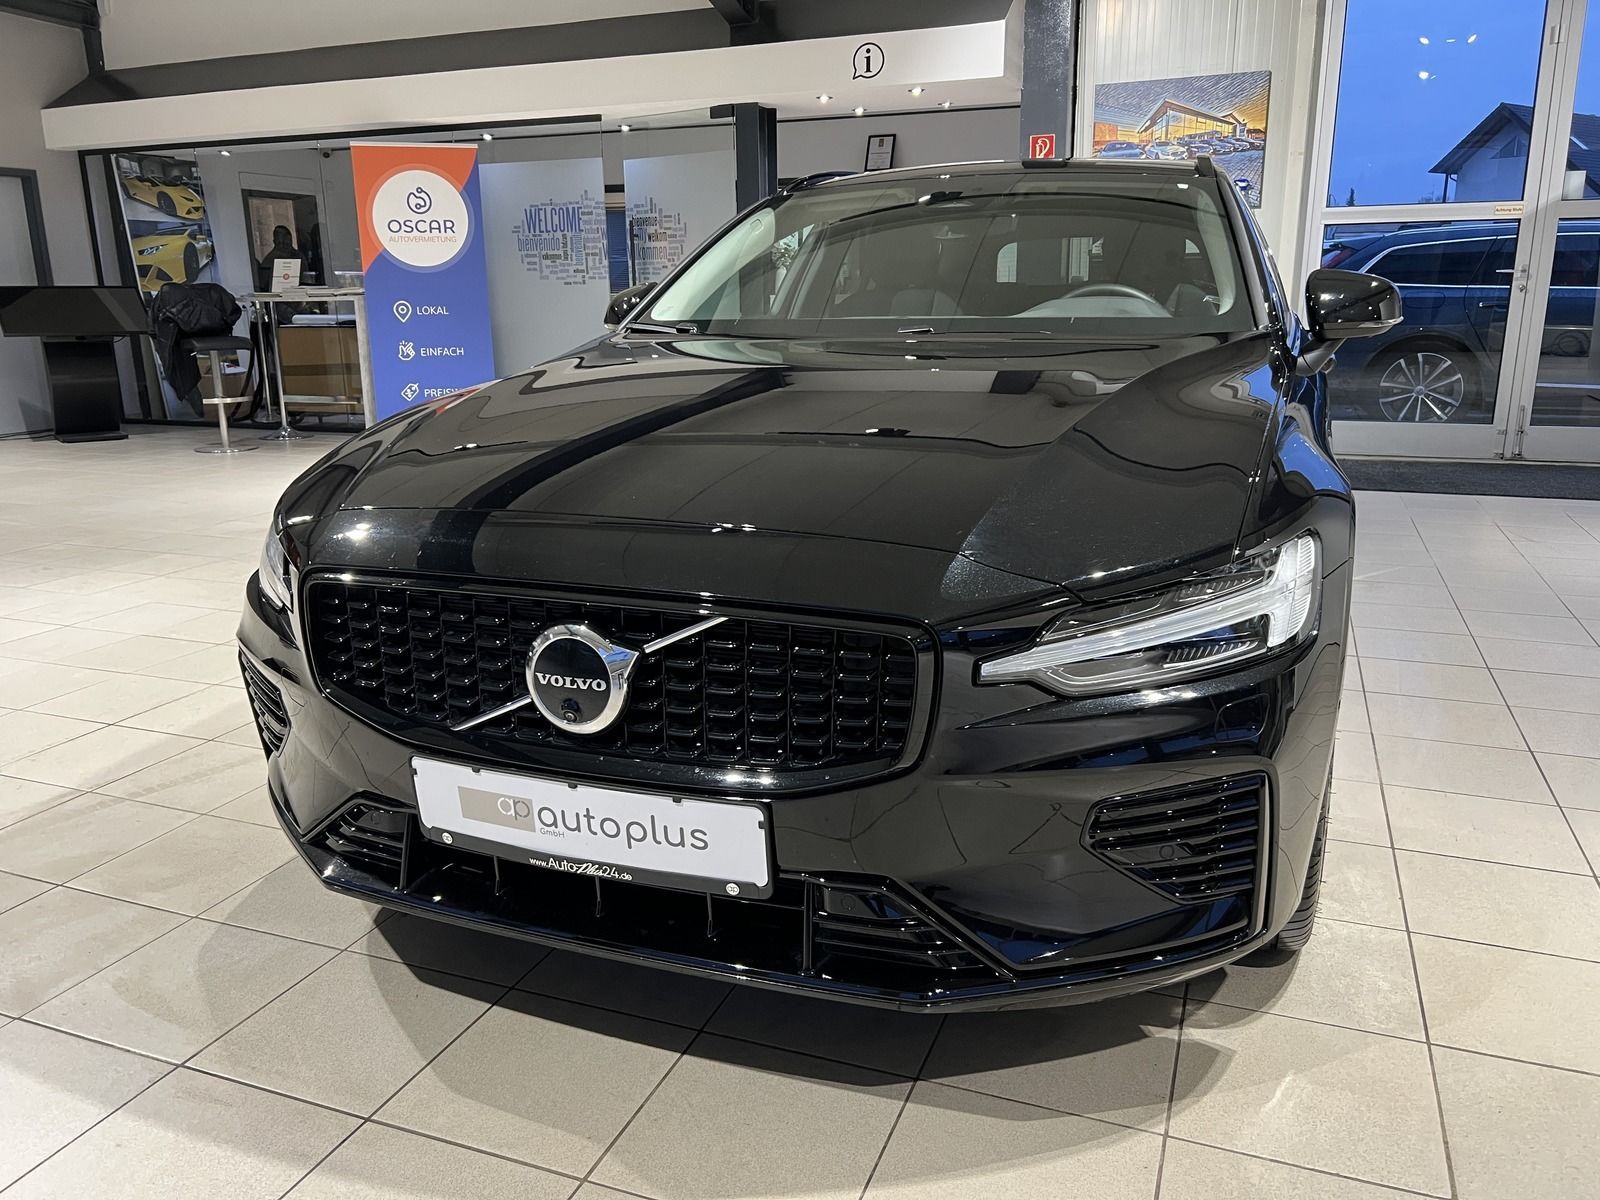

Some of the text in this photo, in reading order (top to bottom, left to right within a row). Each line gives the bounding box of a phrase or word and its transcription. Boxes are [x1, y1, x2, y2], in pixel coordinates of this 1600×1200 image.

[387, 219, 456, 234] OSCAR
[524, 206, 584, 234] WELCOME
[517, 233, 561, 252] bienvenido
[416, 306, 449, 315] LOKAL
[420, 347, 464, 357] EINFACH
[424, 388, 458, 398] PREIS
[535, 672, 607, 692] VOLVO
[537, 806, 709, 851] autoplus
[540, 827, 565, 838] GmbH
